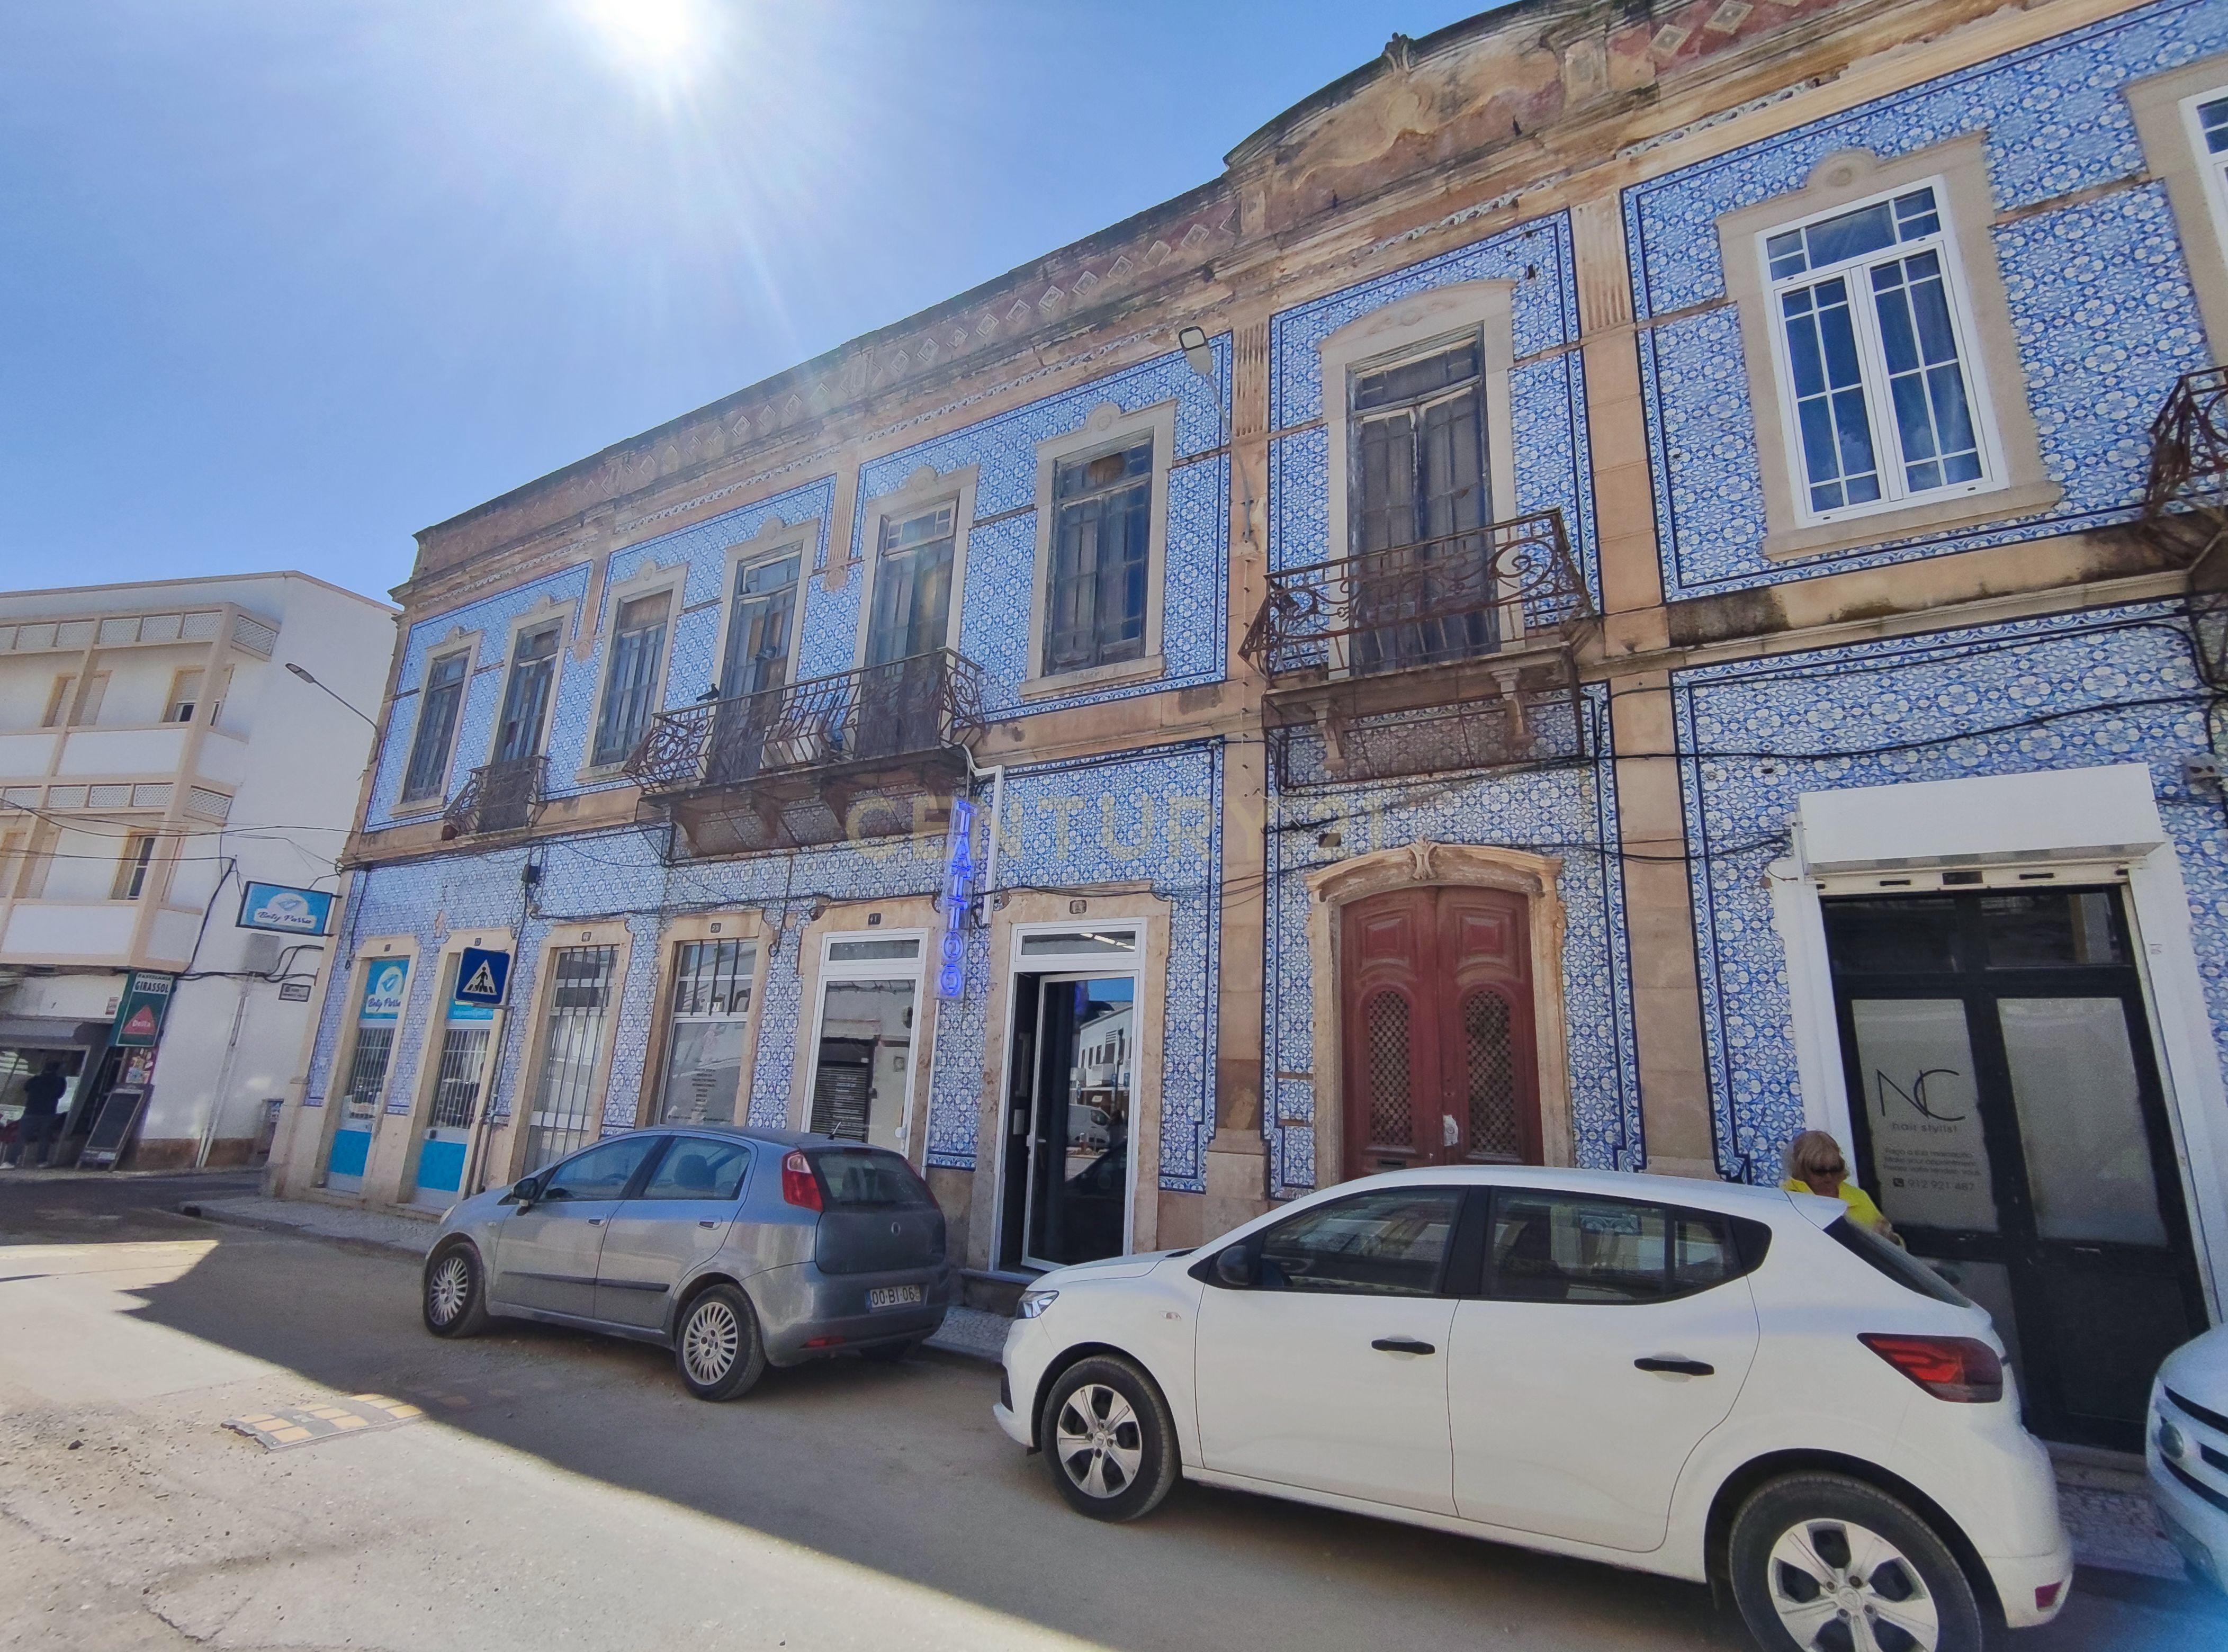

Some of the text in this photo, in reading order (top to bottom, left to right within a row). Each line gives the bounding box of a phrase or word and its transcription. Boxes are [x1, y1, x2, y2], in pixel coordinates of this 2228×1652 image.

[940, 800, 978, 997] TATTOO
[258, 911, 281, 922] Bety
[134, 981, 168, 993] GIRASSOL
[1876, 1069, 1965, 1121] NC
[1892, 1123, 1957, 1134] hair stylist
[1908, 1179, 1928, 1188] 912
